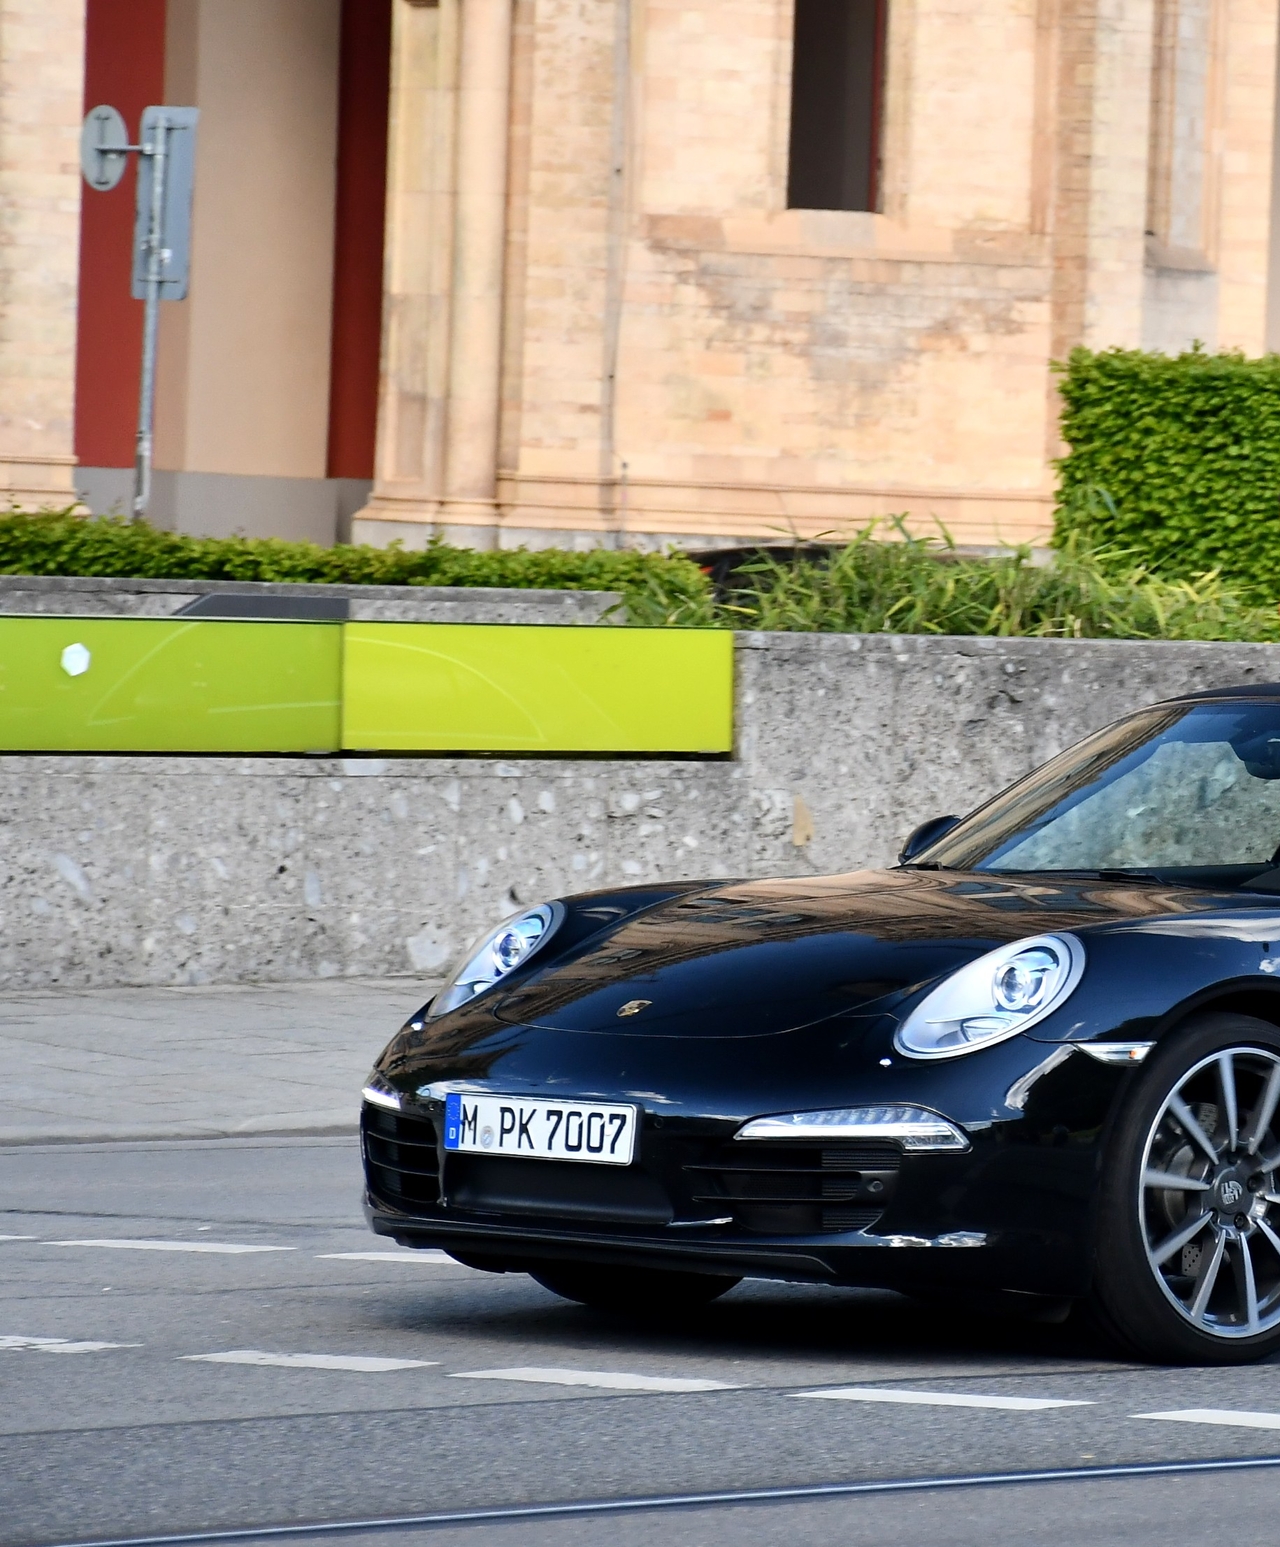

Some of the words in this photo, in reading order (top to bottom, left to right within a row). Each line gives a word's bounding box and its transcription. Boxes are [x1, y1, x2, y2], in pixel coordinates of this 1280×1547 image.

[448, 1127, 457, 1139] D
[461, 1103, 478, 1145] M
[499, 1106, 537, 1149] PK
[546, 1109, 627, 1155] 7007
